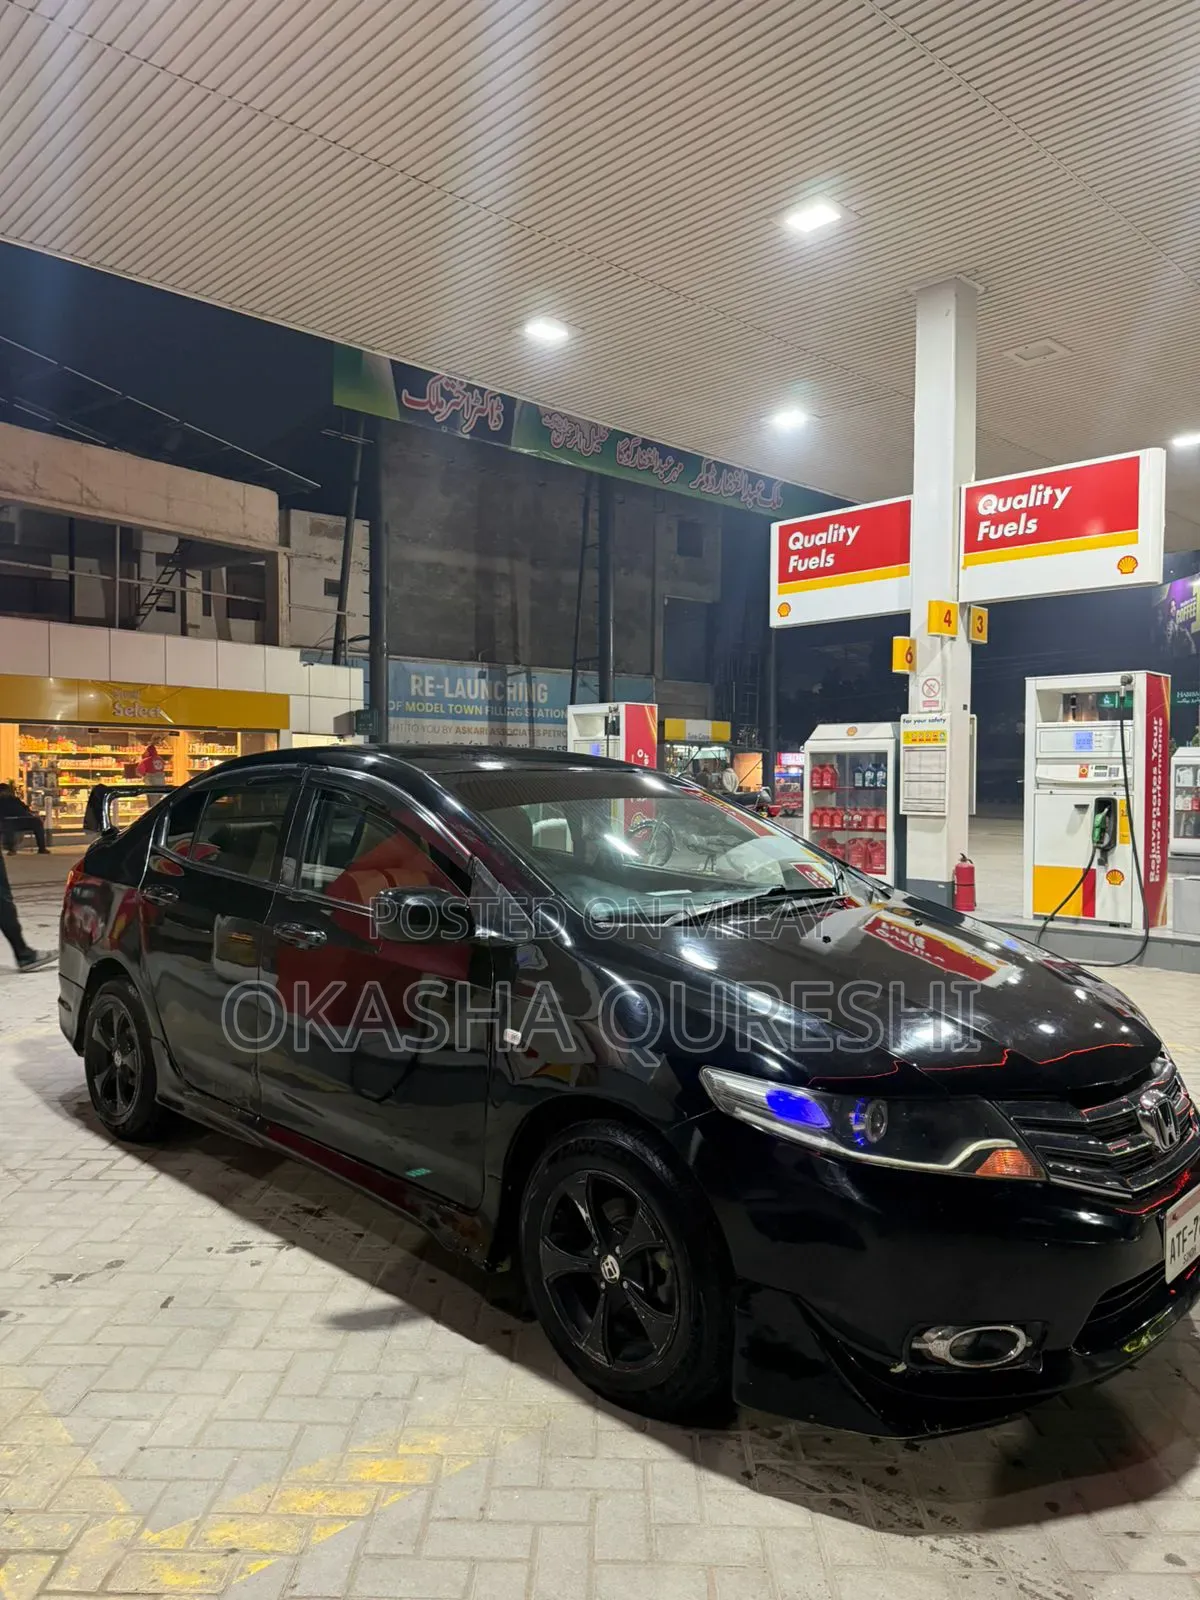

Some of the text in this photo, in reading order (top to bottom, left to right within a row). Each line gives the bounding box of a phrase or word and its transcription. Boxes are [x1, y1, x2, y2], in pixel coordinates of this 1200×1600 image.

[978, 484, 1072, 515] Quality
[788, 523, 860, 551] Quality
[977, 513, 1038, 541] Fuels
[788, 549, 835, 573] Fuels
[943, 609, 952, 627] 4
[977, 615, 984, 633] 3
[906, 646, 914, 664] 6
[411, 674, 548, 703] RE-LAUNCHING
[113, 701, 161, 718] Select
[405, 700, 445, 713] MODEL
[448, 703, 483, 716] TOWN
[485, 704, 523, 717] FILLING
[1149, 767, 1157, 882] Rejuvenates
[1170, 1214, 1200, 1264] ATF-7
